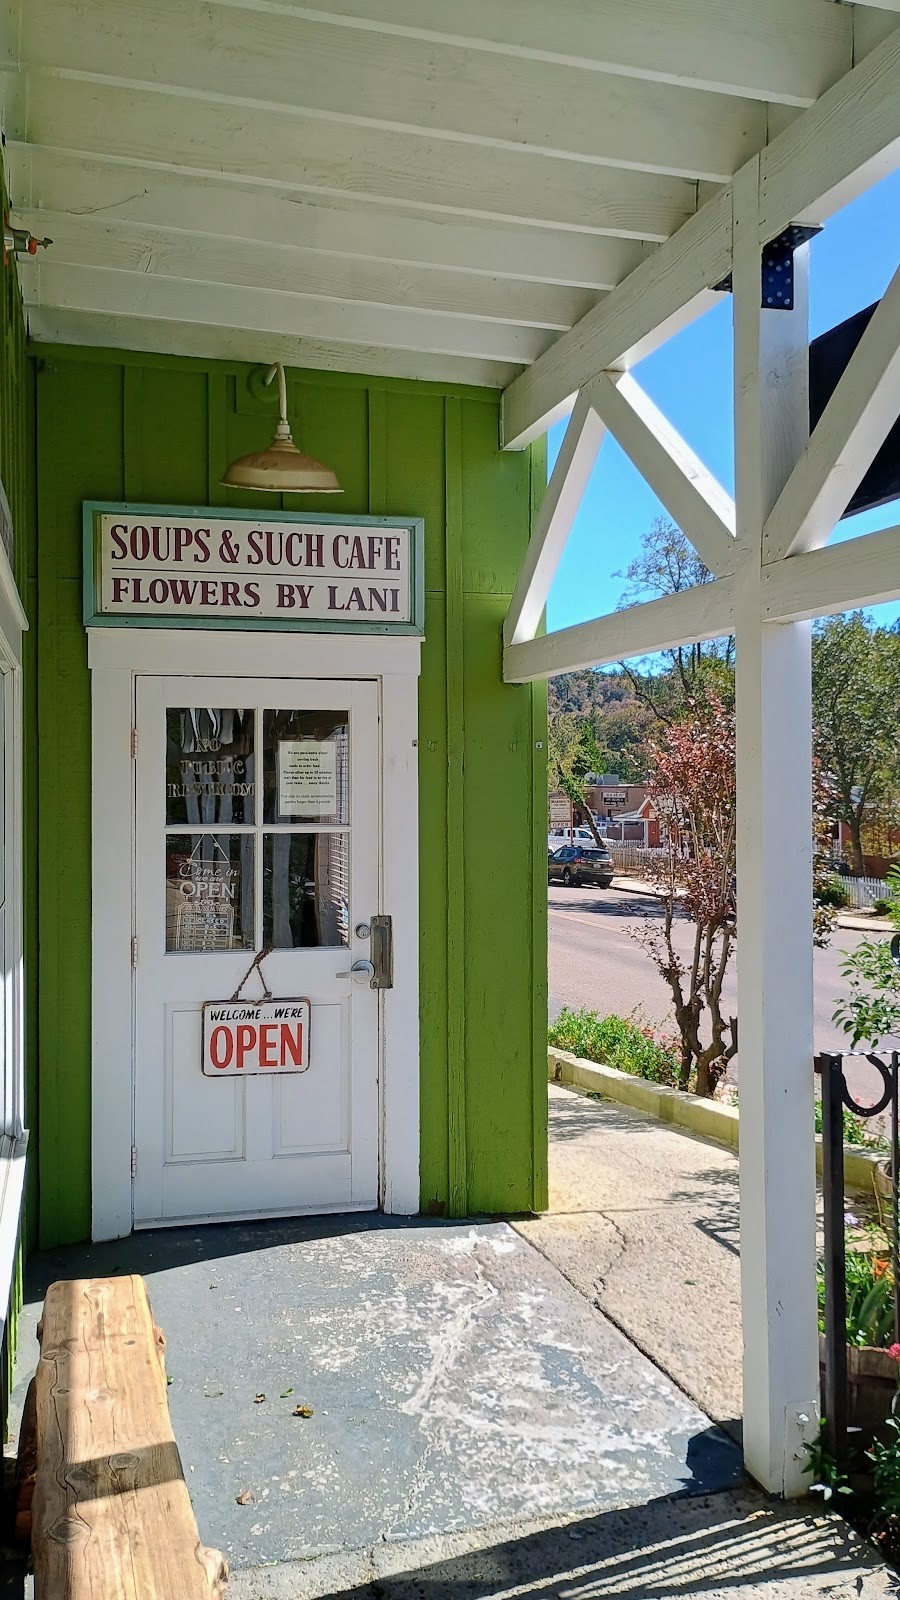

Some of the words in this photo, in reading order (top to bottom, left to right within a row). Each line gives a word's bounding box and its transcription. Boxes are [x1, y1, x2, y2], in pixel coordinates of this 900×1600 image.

[110, 524, 211, 564] SOUPS
[218, 529, 240, 564] &
[247, 530, 325, 568] SUCH
[111, 577, 260, 607] FLOWERS
[276, 583, 314, 609] BY
[327, 585, 400, 612] LANI
[195, 737, 222, 753] NO
[180, 760, 244, 775] PUBLIC
[179, 861, 222, 877] Come
[226, 867, 239, 877] in
[180, 881, 236, 899] OPEN
[210, 1009, 262, 1021] WELCOME
[209, 1022, 303, 1069] OPEN
